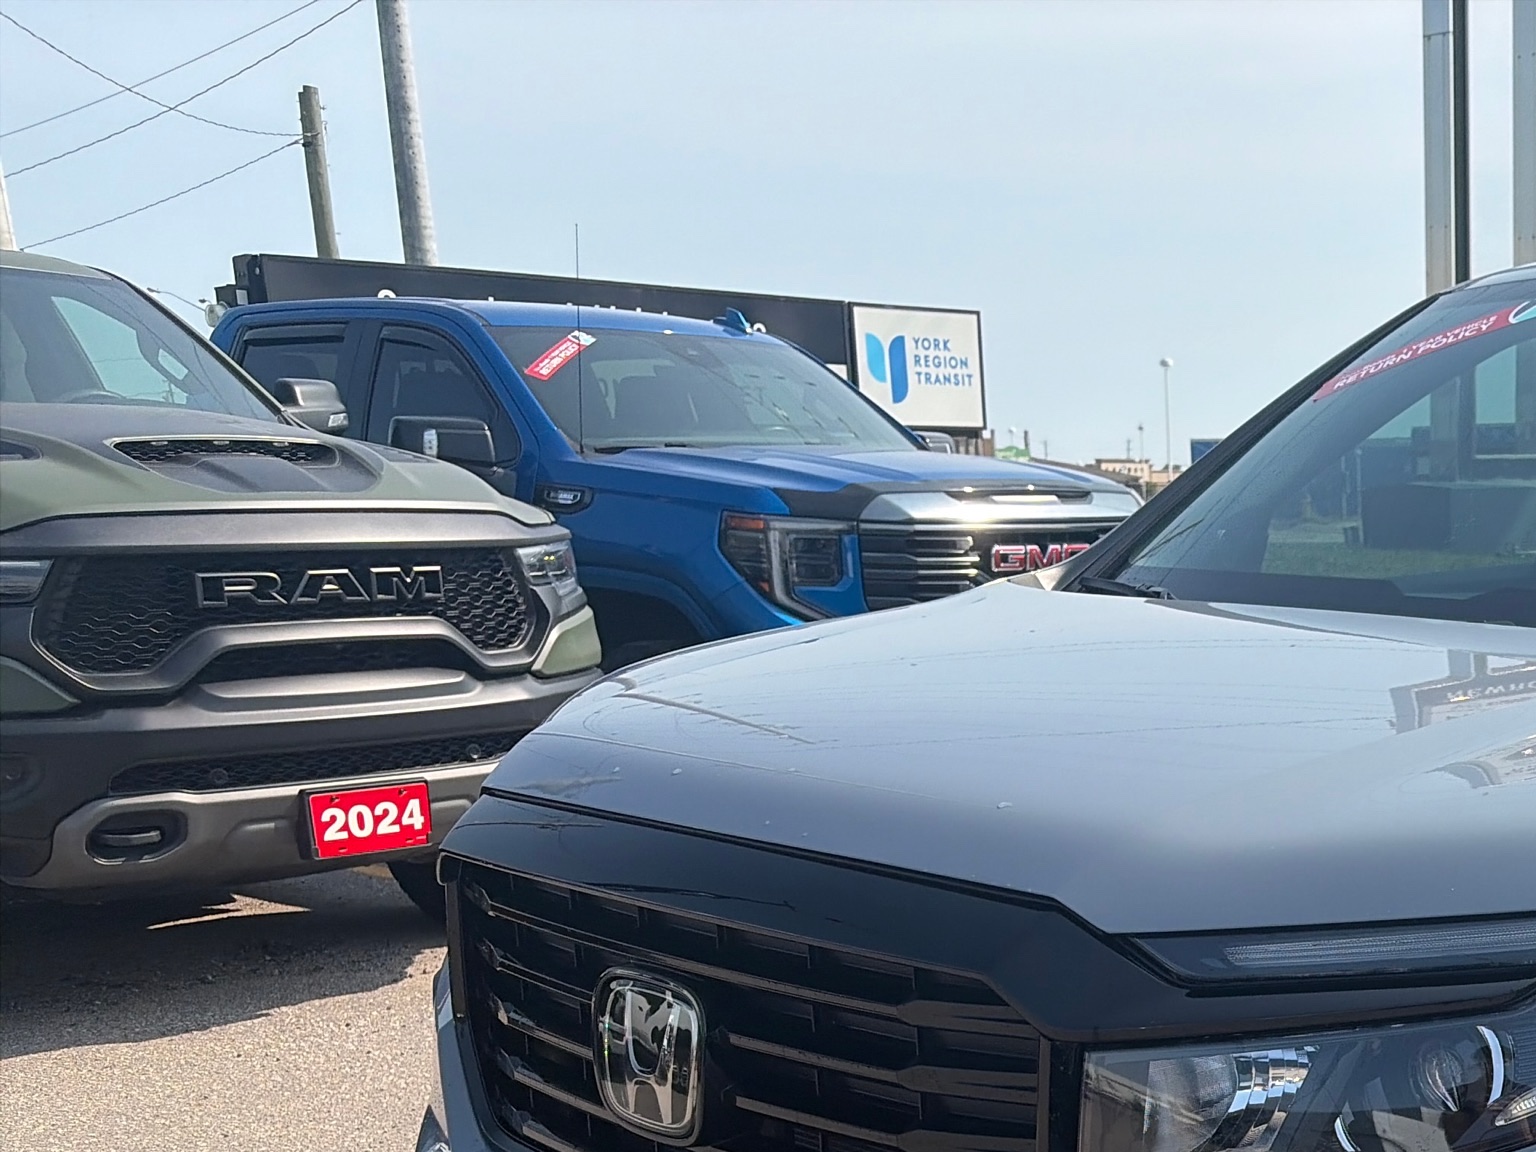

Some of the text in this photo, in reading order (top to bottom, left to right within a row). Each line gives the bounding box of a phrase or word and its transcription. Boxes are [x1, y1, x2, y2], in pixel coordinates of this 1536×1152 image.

[912, 336, 951, 352] YORK
[1412, 334, 1444, 349] YEAR
[1446, 315, 1498, 337] VEHICLE
[914, 354, 969, 369] REGION
[1333, 320, 1497, 389] RETURN POLICY
[915, 371, 974, 387] TRANSIT
[195, 565, 445, 608] RAM
[320, 798, 425, 842] 2024
